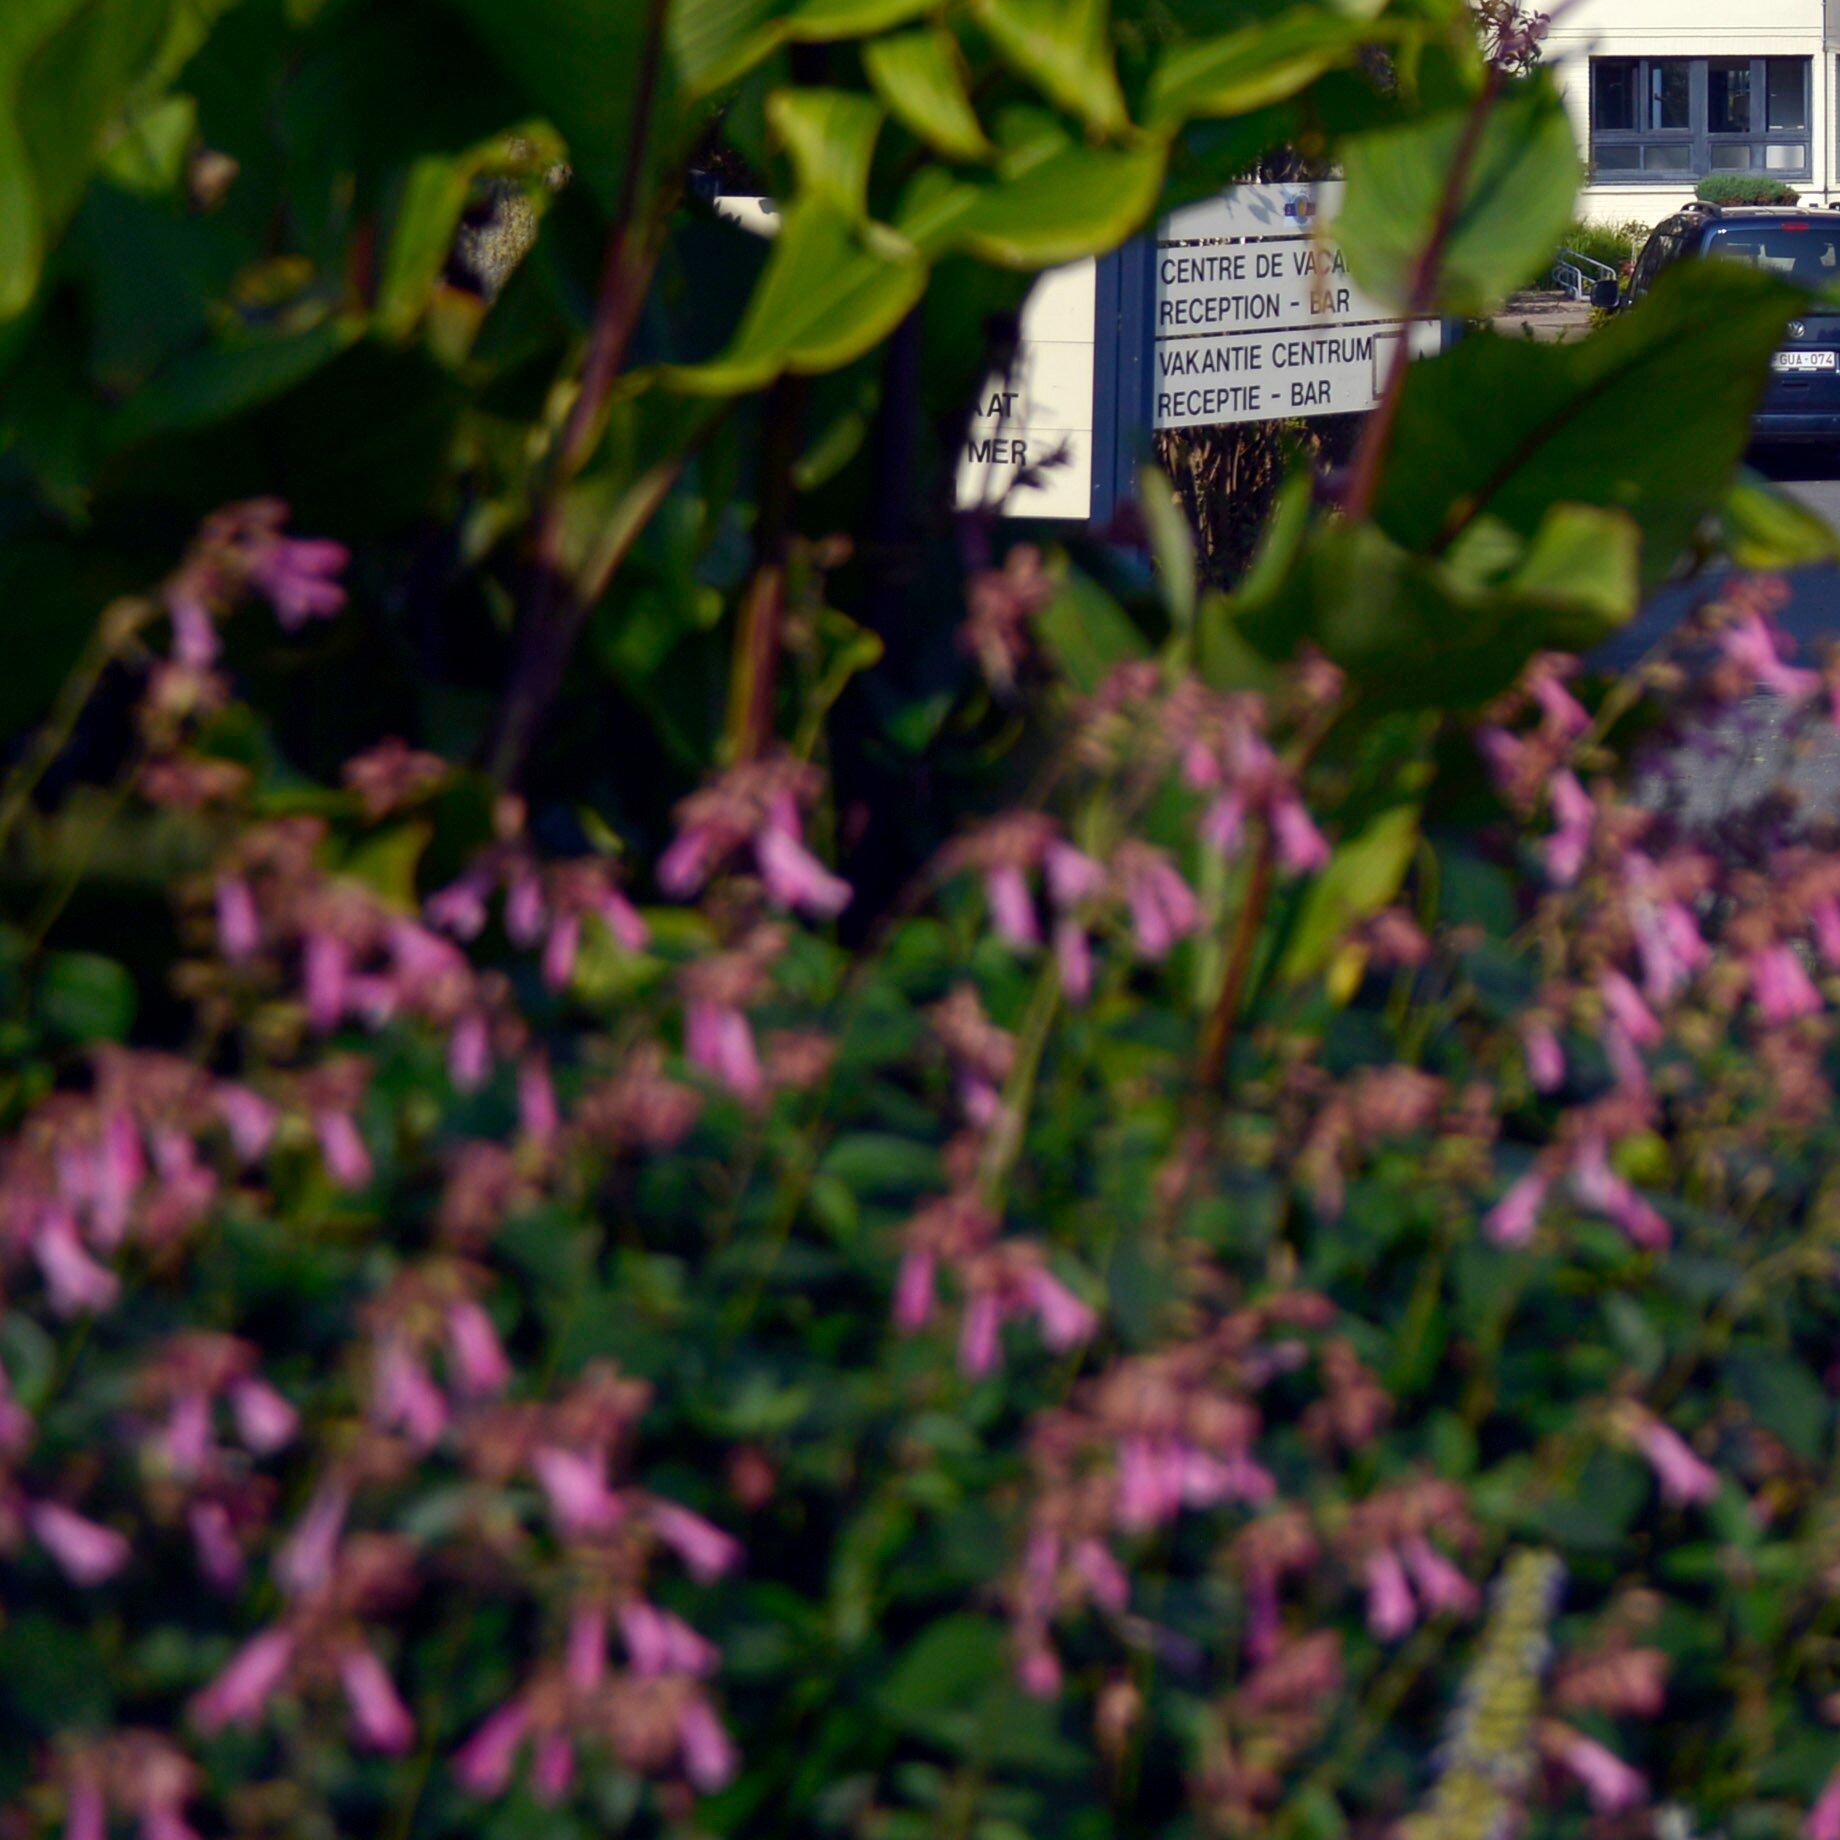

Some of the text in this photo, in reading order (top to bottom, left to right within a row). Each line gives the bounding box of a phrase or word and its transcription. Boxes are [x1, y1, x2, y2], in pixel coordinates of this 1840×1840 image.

[1161, 255, 1246, 285] CENTRE
[1256, 253, 1283, 278] DE
[1160, 294, 1280, 325] RECEPTION
[1310, 289, 1350, 315] BAR
[1159, 337, 1373, 376] VAKANTIE CENTRUM
[1158, 386, 1260, 418] RECEPTIE
[1291, 380, 1332, 407] BAR
